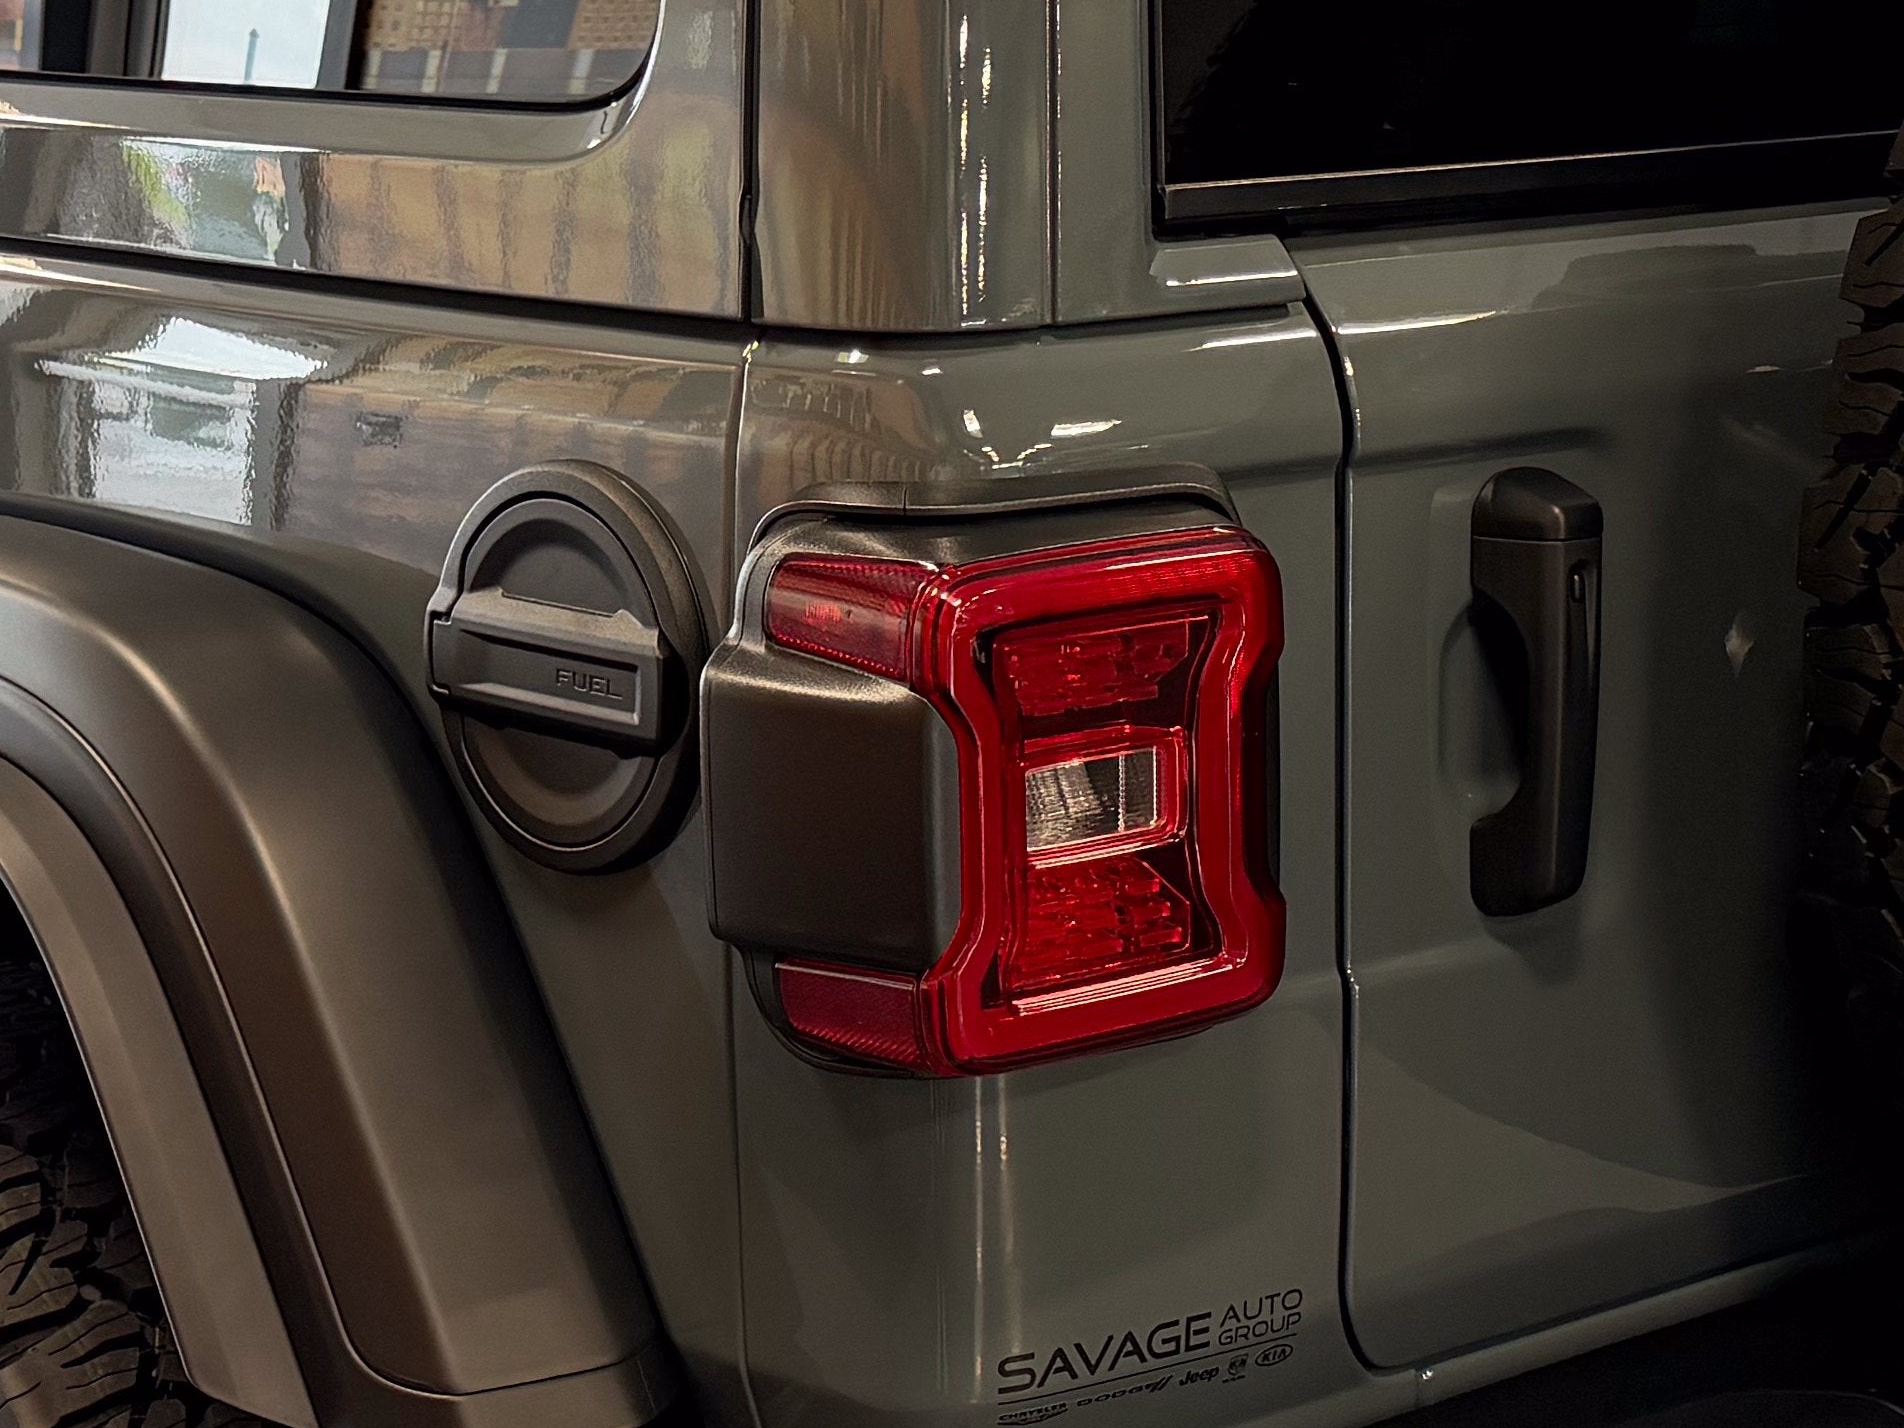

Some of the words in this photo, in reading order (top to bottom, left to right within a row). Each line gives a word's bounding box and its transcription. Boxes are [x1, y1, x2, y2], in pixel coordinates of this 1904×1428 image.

[555, 667, 624, 701] FUEL
[996, 1311, 1213, 1396] SAVAGE
[1218, 1287, 1304, 1329] AUTO
[1217, 1310, 1303, 1347] GROUP
[1178, 1363, 1221, 1388] Jeep
[1257, 1345, 1291, 1366] KIA
